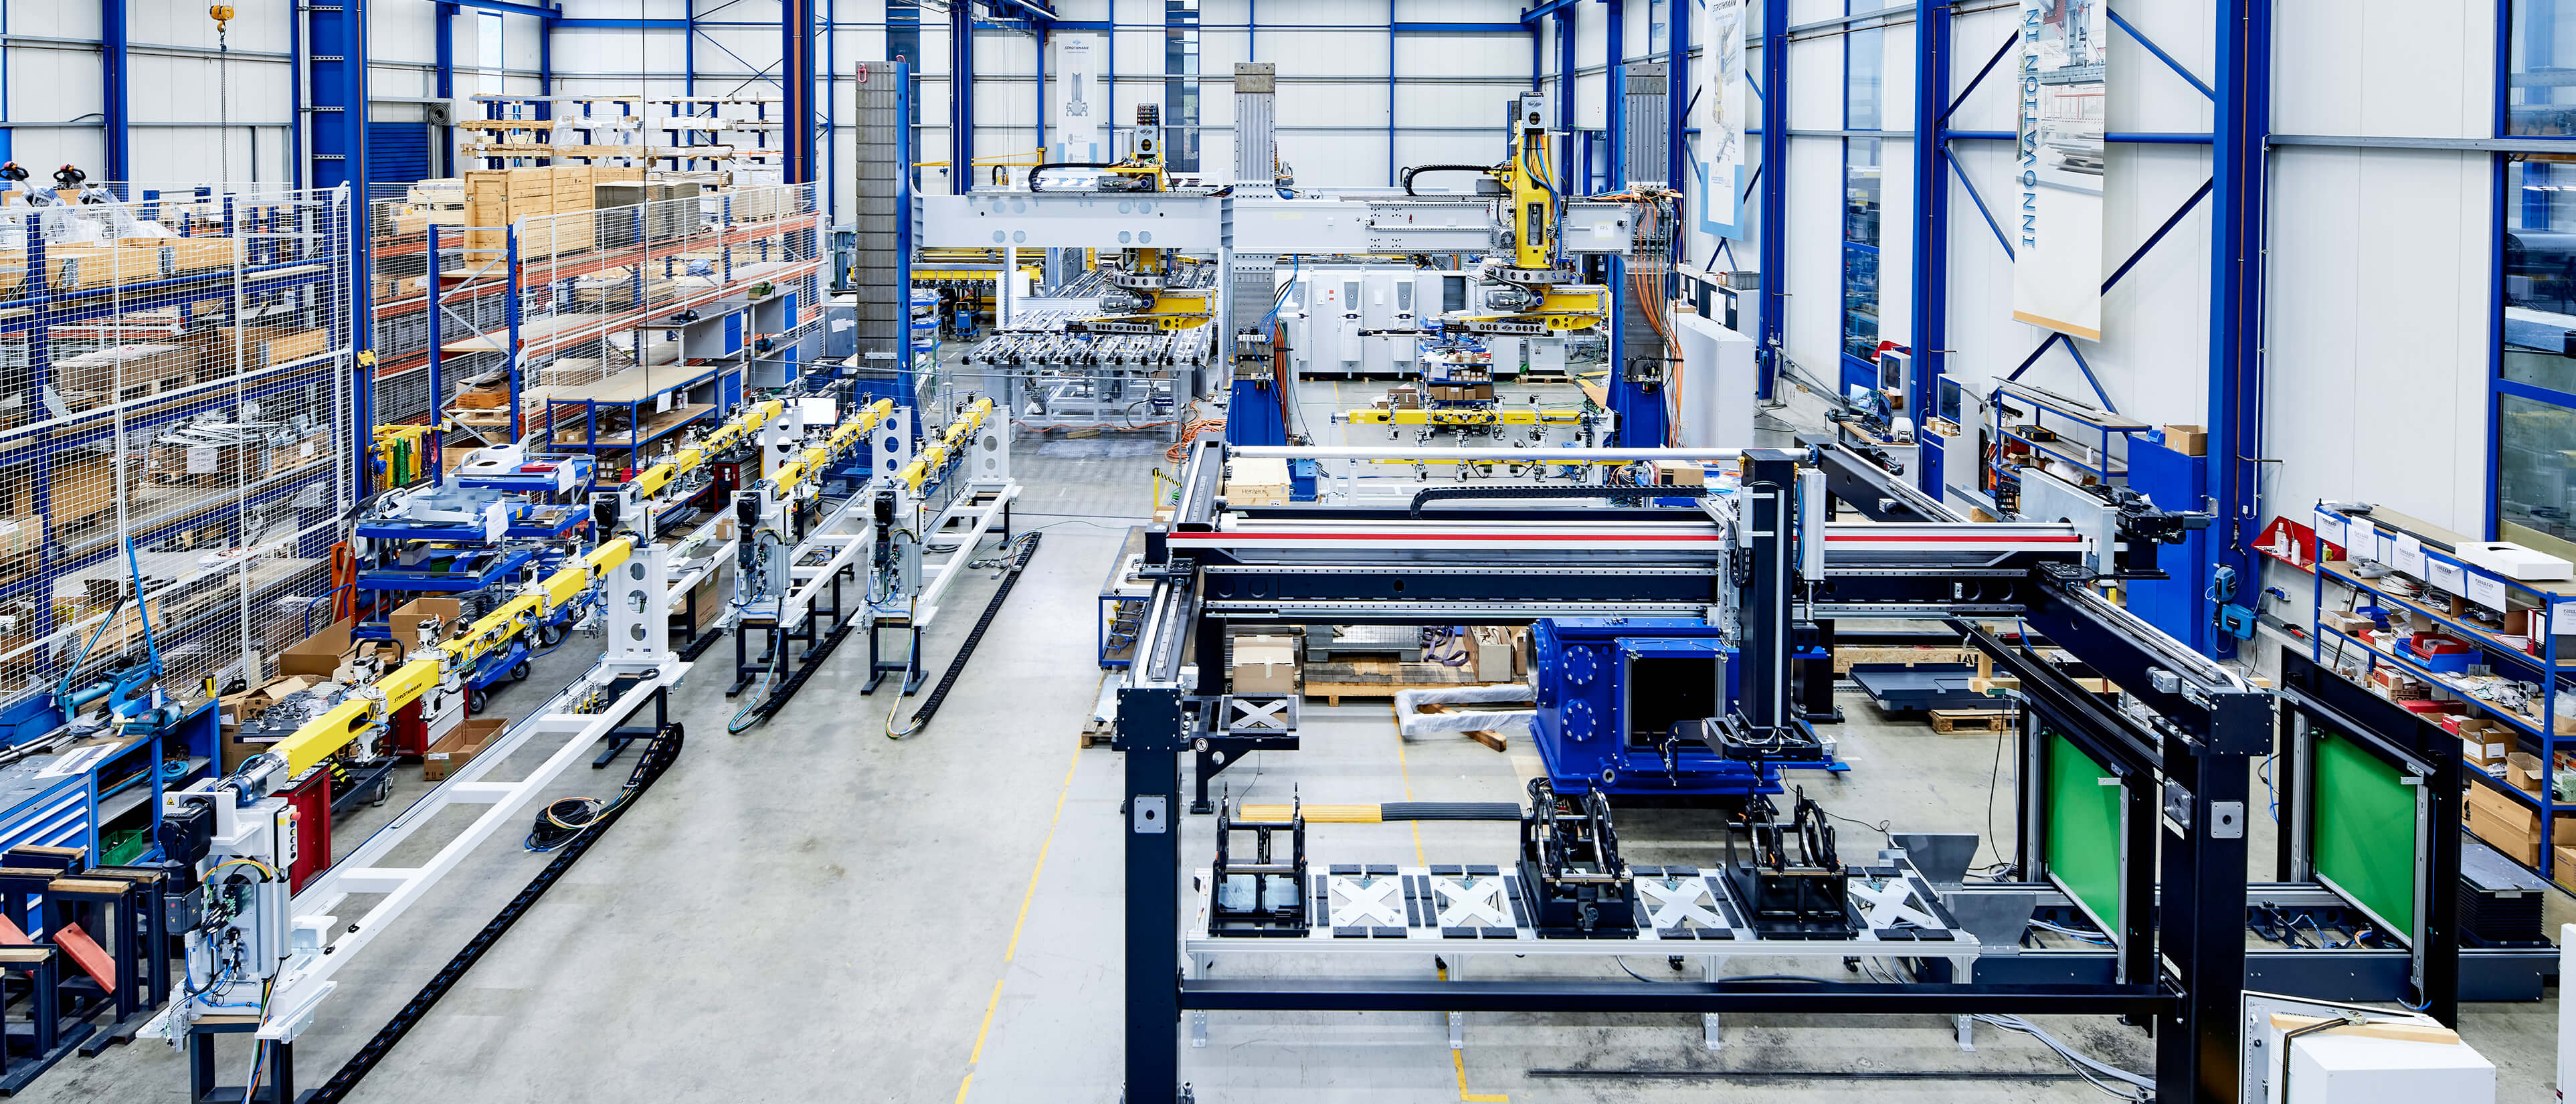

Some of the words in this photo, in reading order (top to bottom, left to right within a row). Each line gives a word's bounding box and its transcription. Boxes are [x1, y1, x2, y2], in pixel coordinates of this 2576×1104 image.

[2026, 9, 2039, 43] IN
[2023, 55, 2039, 248] INNOVATION
[394, 681, 422, 703] STROTHMANN
